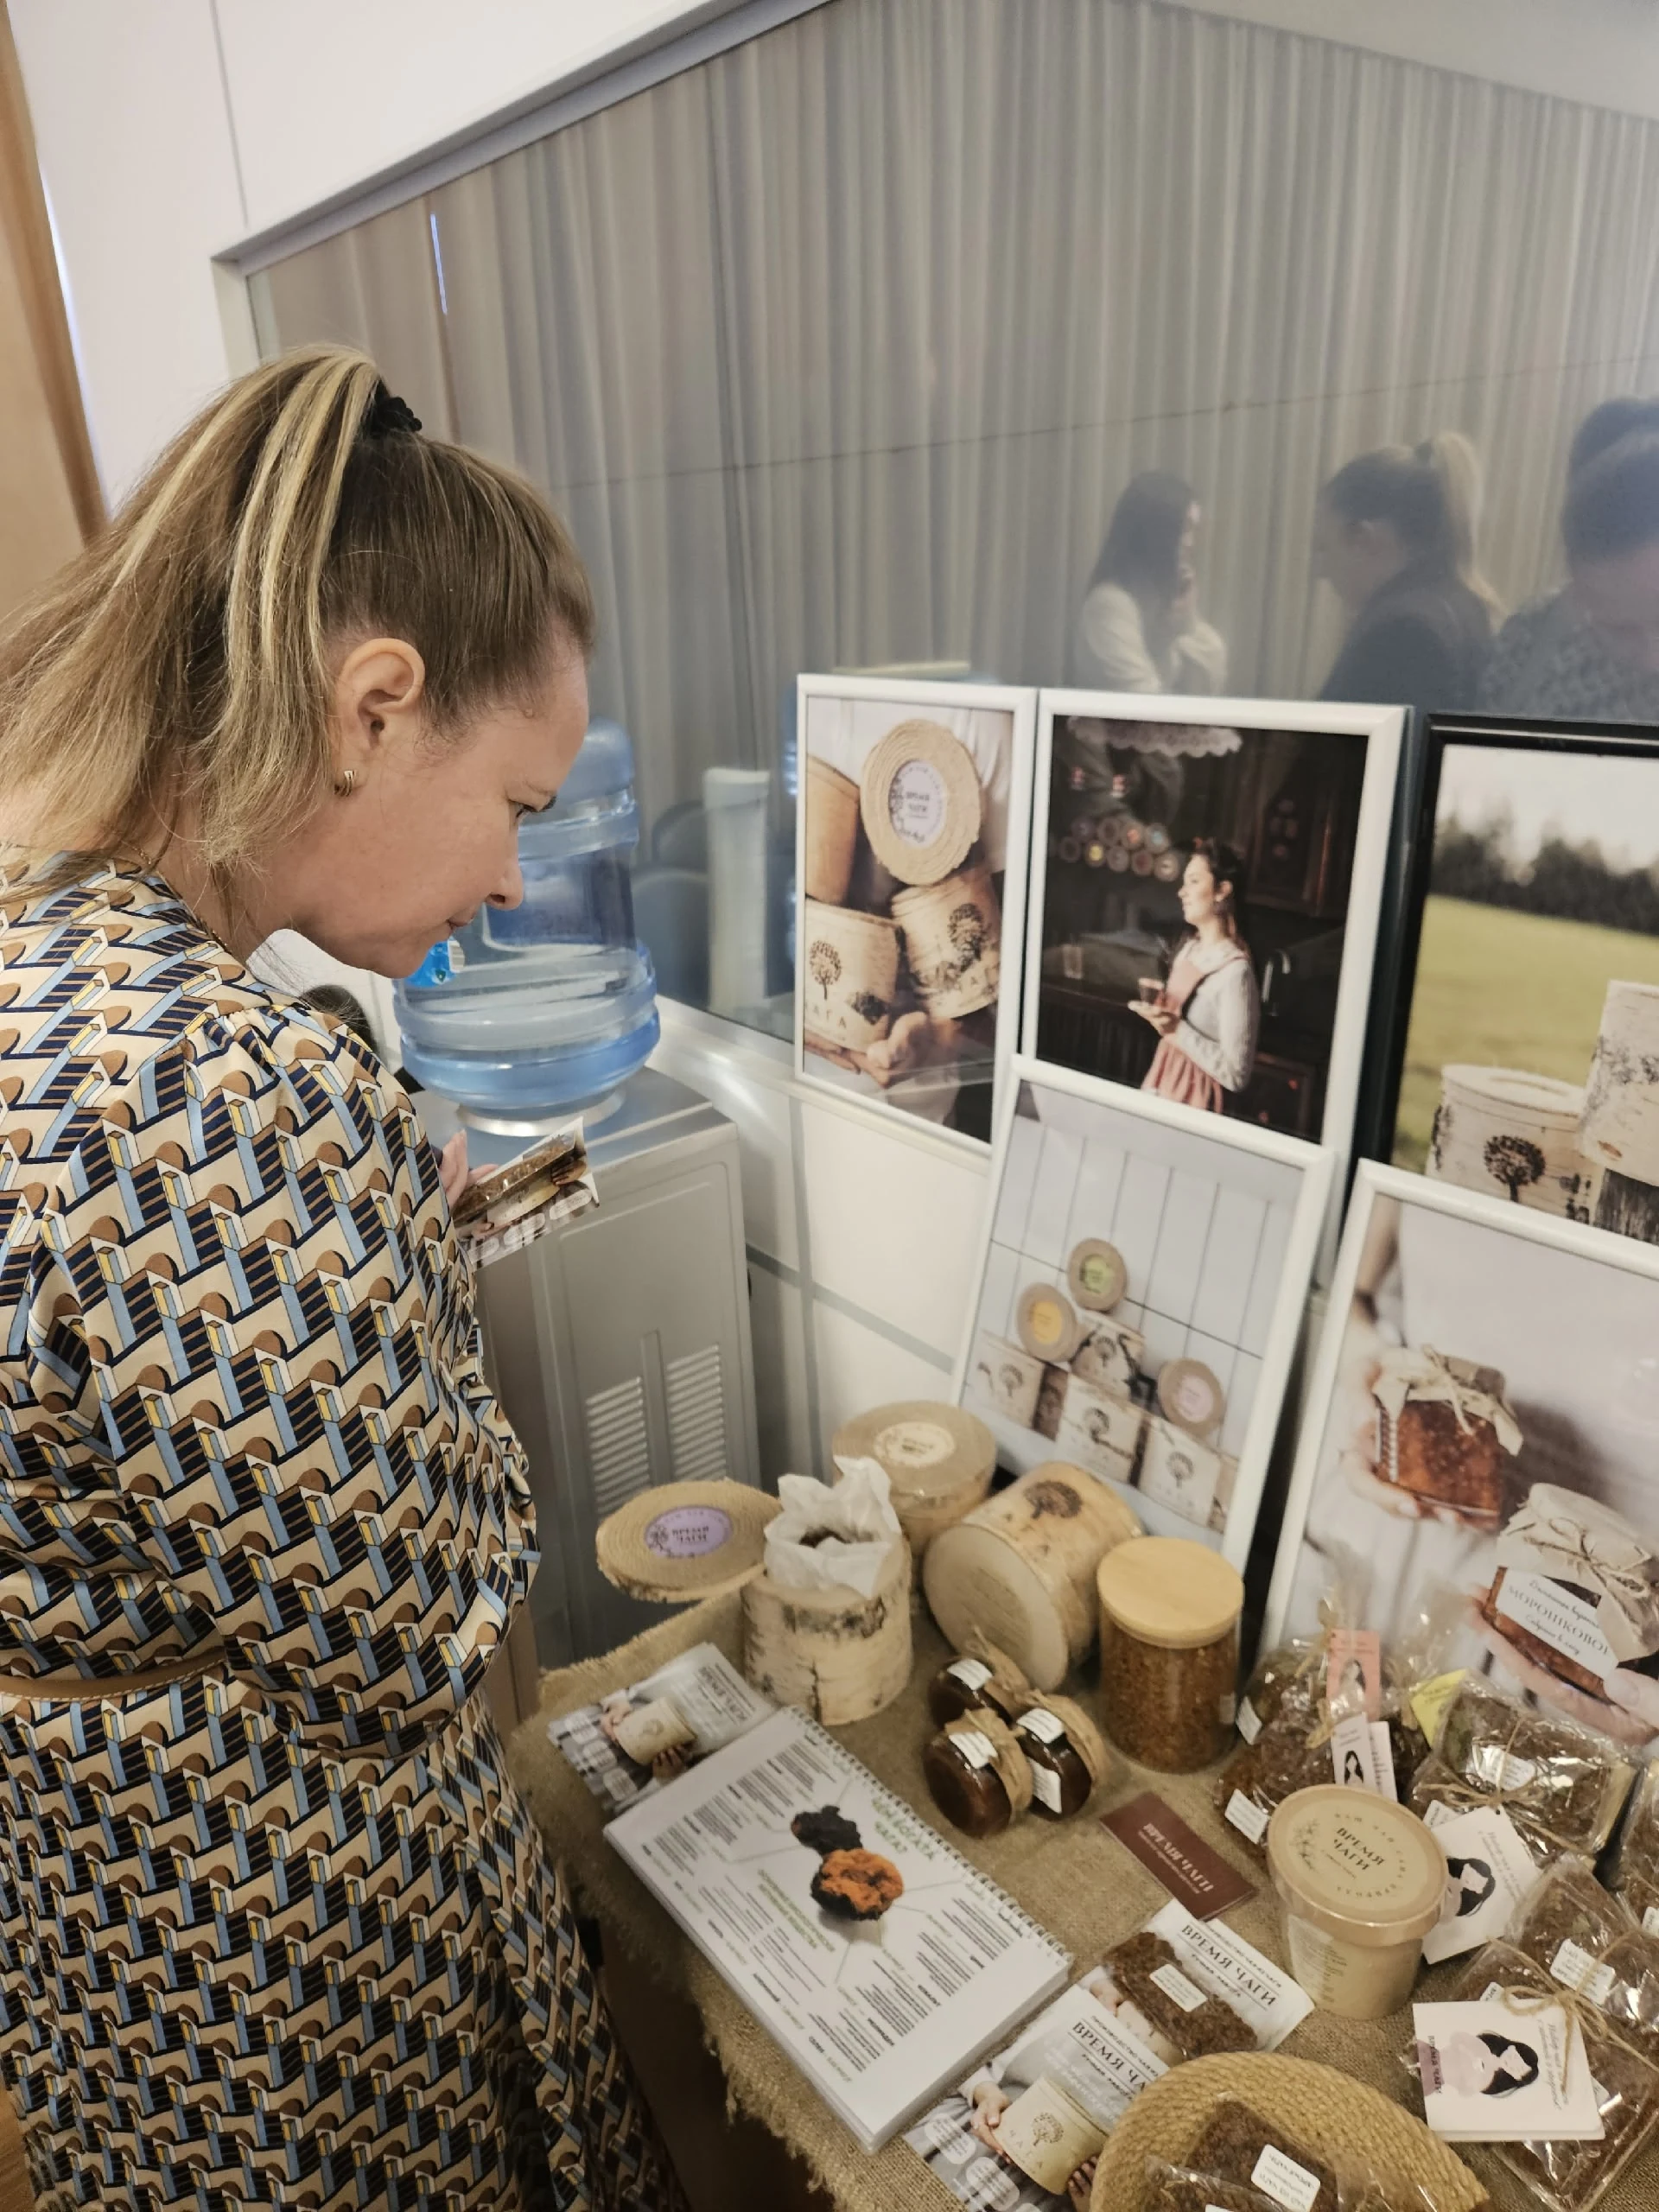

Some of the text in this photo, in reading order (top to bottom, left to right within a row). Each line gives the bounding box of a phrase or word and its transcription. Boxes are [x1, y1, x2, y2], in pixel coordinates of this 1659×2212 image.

[1333, 1839, 1370, 1870] ЧАГИ
[1337, 1827, 1385, 1865] ВРЕМЯ
[1179, 1923, 1234, 1971] ВРЕМЯ
[1230, 1966, 1277, 2007] ЧАГИ
[1071, 2020, 1126, 2071] ВРЕМЯ
